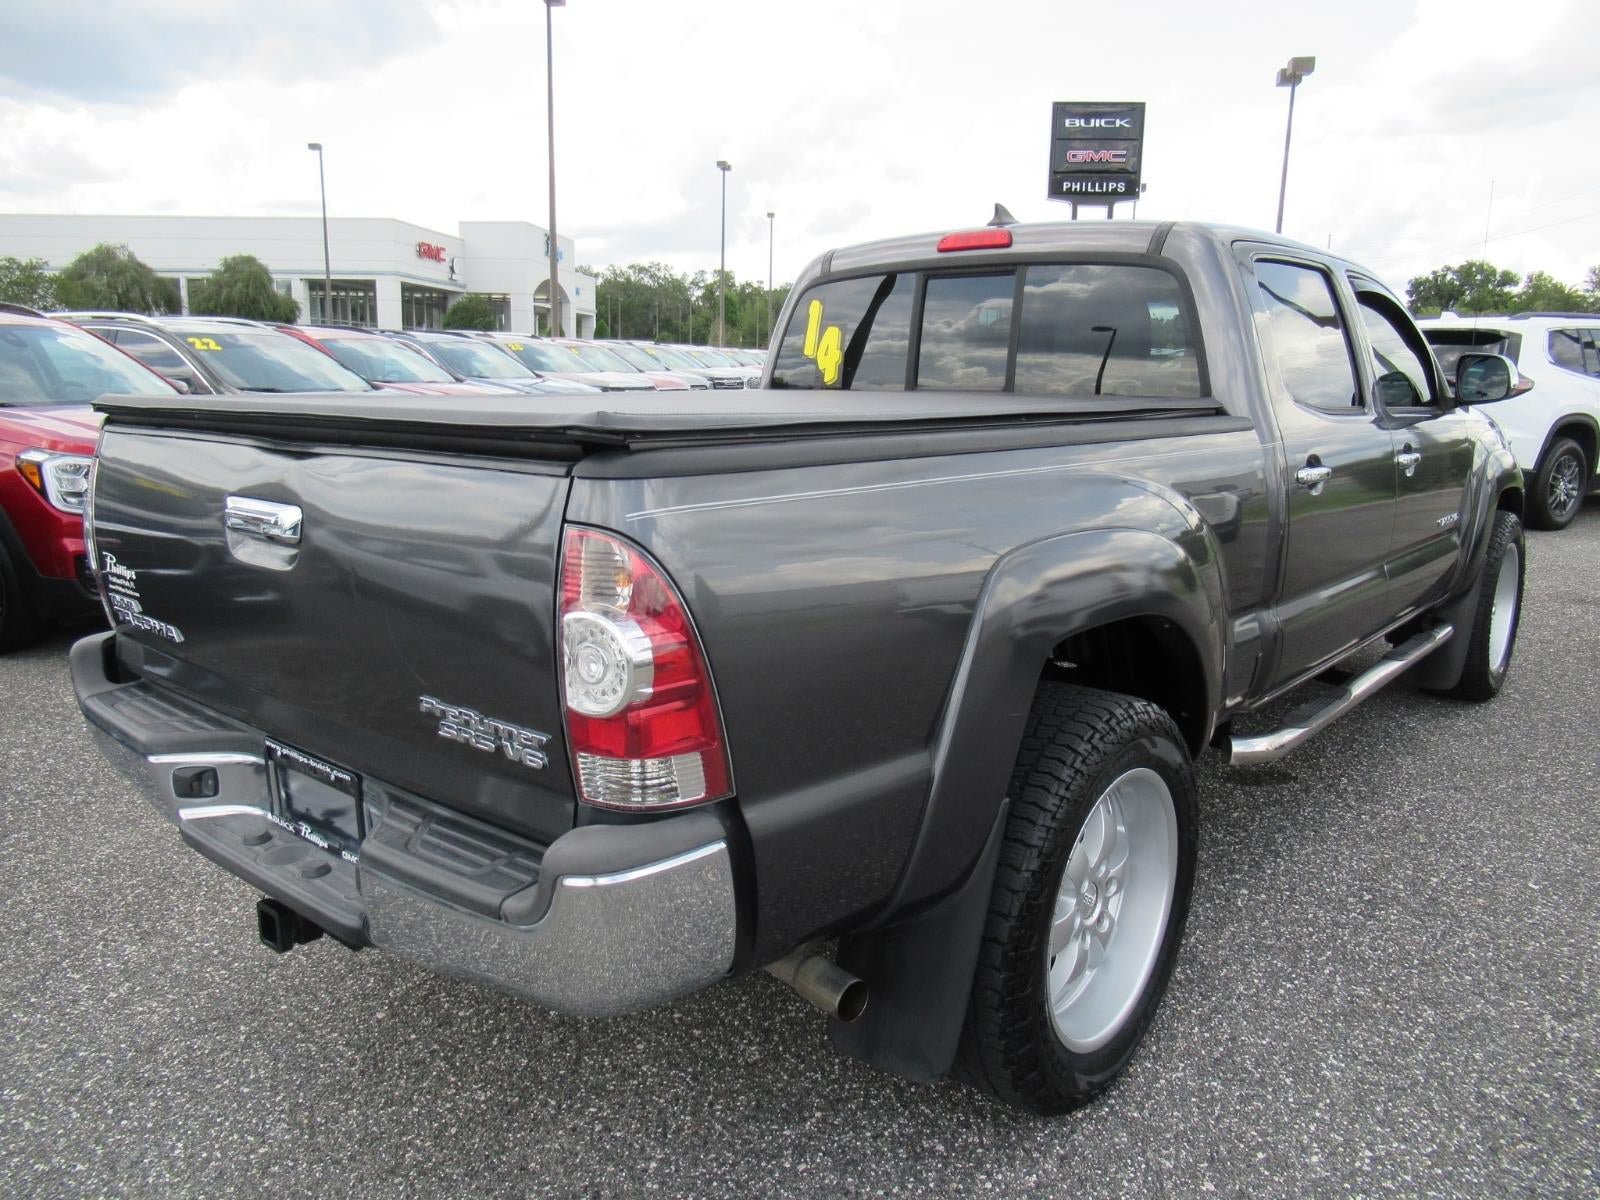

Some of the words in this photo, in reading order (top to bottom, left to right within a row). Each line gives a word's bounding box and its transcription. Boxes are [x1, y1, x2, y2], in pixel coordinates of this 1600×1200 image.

[1064, 118, 1131, 128] BUICK
[1066, 150, 1127, 163] GMC
[1062, 181, 1126, 192] PHILLIPS
[419, 241, 446, 262] GMC
[187, 337, 223, 350] 22
[102, 551, 136, 580] Phillips
[419, 695, 552, 746] PreRunner
[438, 721, 496, 753] SR5
[501, 738, 549, 770] V6
[264, 740, 351, 782] www.phillips-buick.com
[298, 821, 329, 849] Phillips
